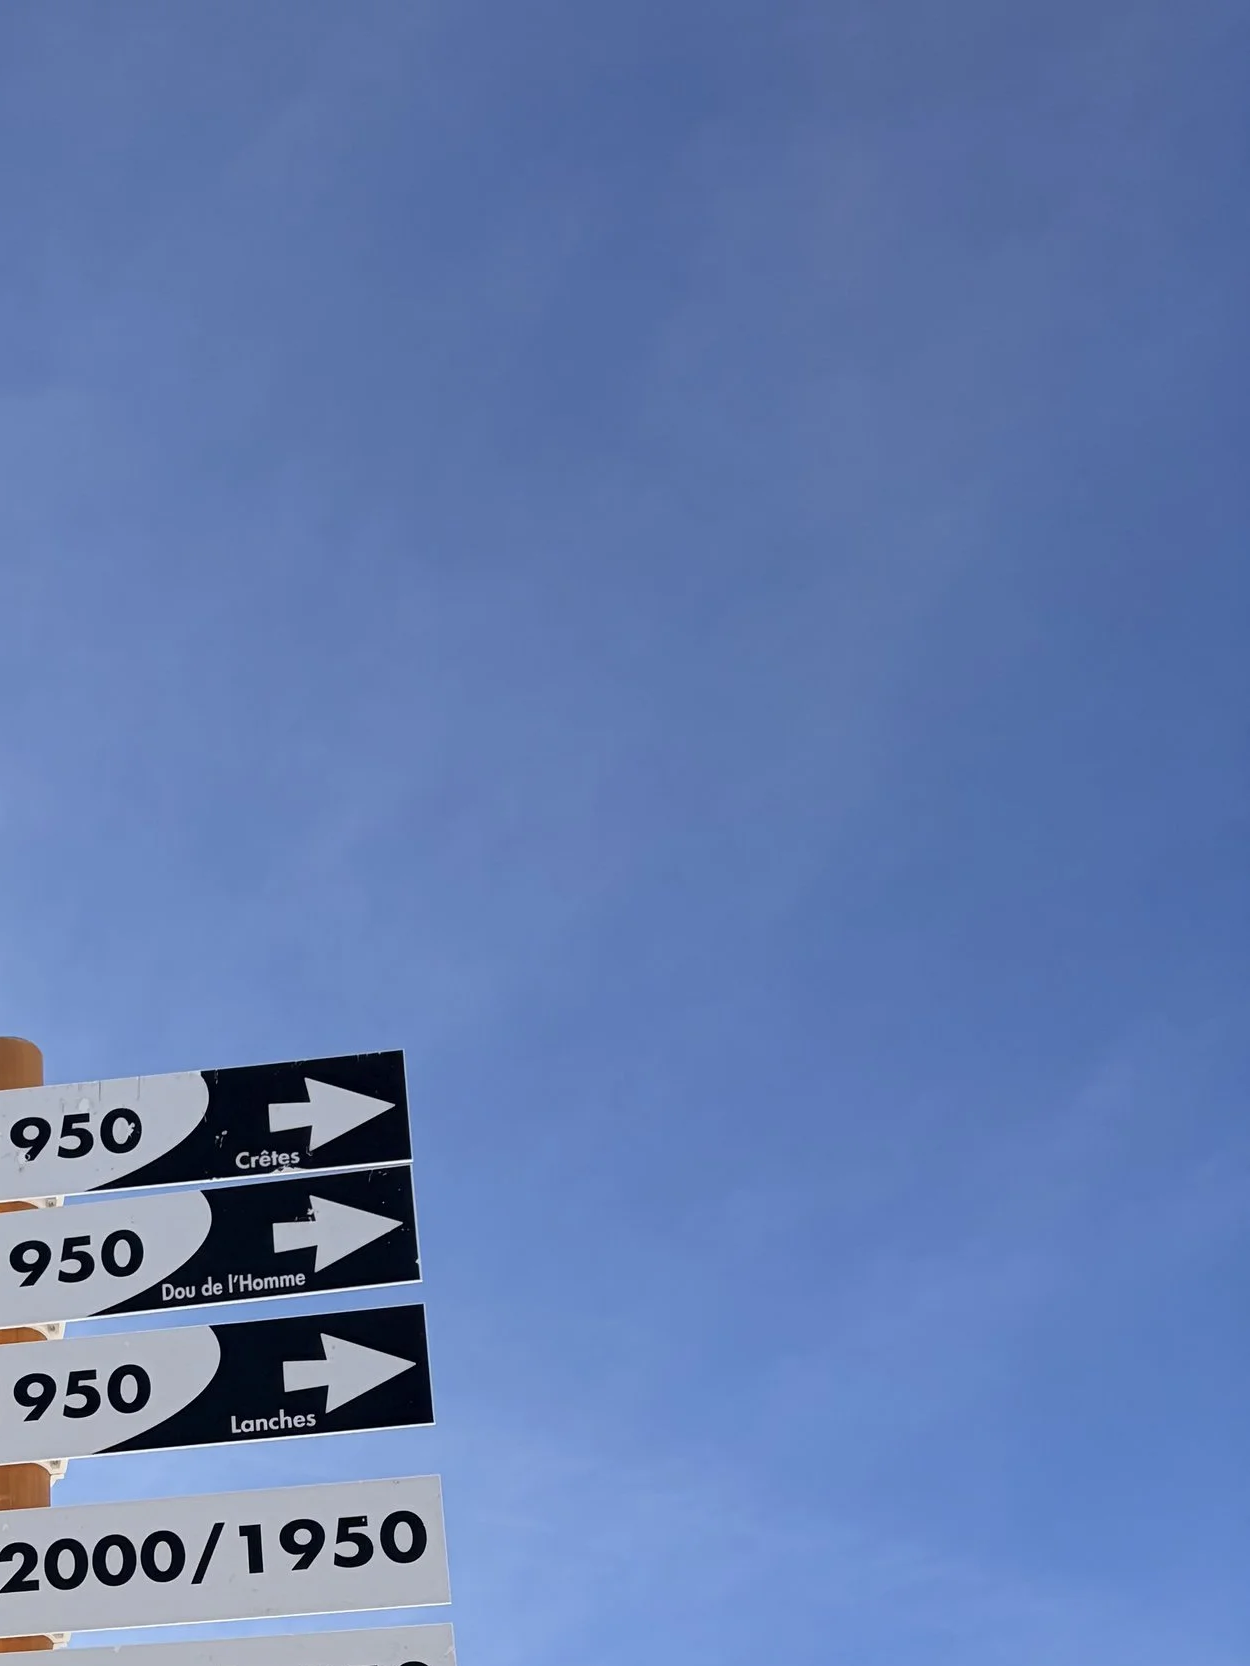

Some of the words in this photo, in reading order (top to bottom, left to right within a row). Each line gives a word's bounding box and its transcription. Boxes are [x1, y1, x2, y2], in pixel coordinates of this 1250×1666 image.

[235, 1149, 301, 1170] Crêtes
[161, 1283, 196, 1301] Dou
[201, 1276, 223, 1297] de
[228, 1273, 306, 1294] l'Homme
[230, 1408, 317, 1434] Lanches
